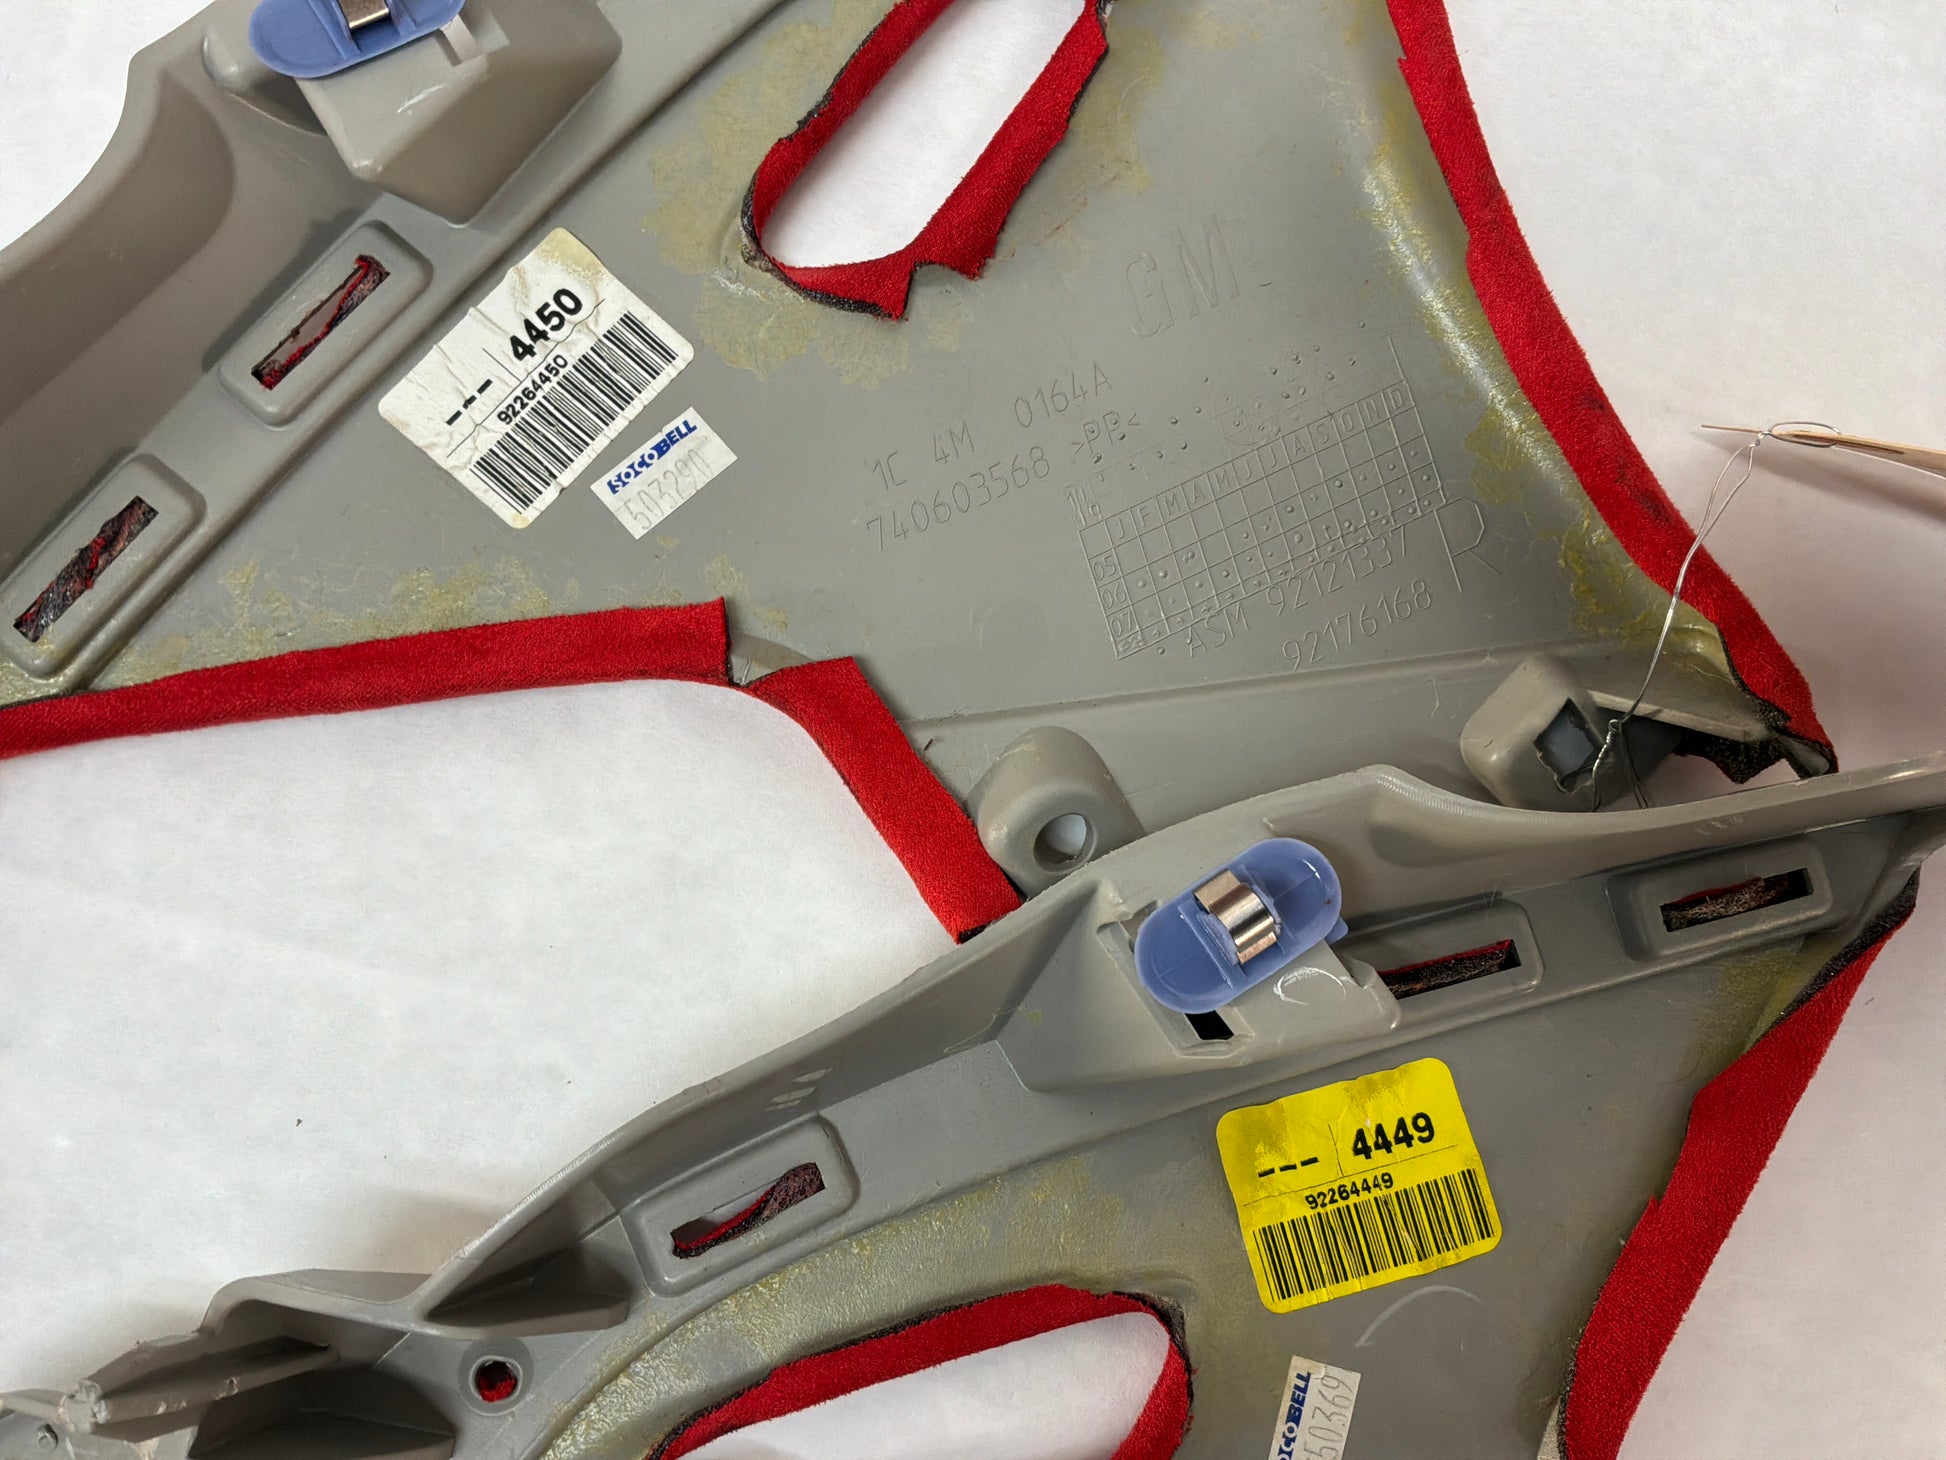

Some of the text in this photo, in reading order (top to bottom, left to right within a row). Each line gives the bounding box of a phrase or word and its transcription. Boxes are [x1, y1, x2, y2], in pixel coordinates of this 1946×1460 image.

[508, 287, 584, 363] 4450
[497, 353, 568, 426] 92264450
[1014, 361, 1112, 429] 0164A
[606, 419, 698, 495] SOCOBELL
[866, 445, 1050, 551] 740603568
[1433, 496, 1504, 594] R
[1186, 602, 1249, 659] ASM
[1281, 576, 1433, 673] 92176168
[1352, 1111, 1436, 1160] 4449
[1304, 1171, 1395, 1211] 92264449
